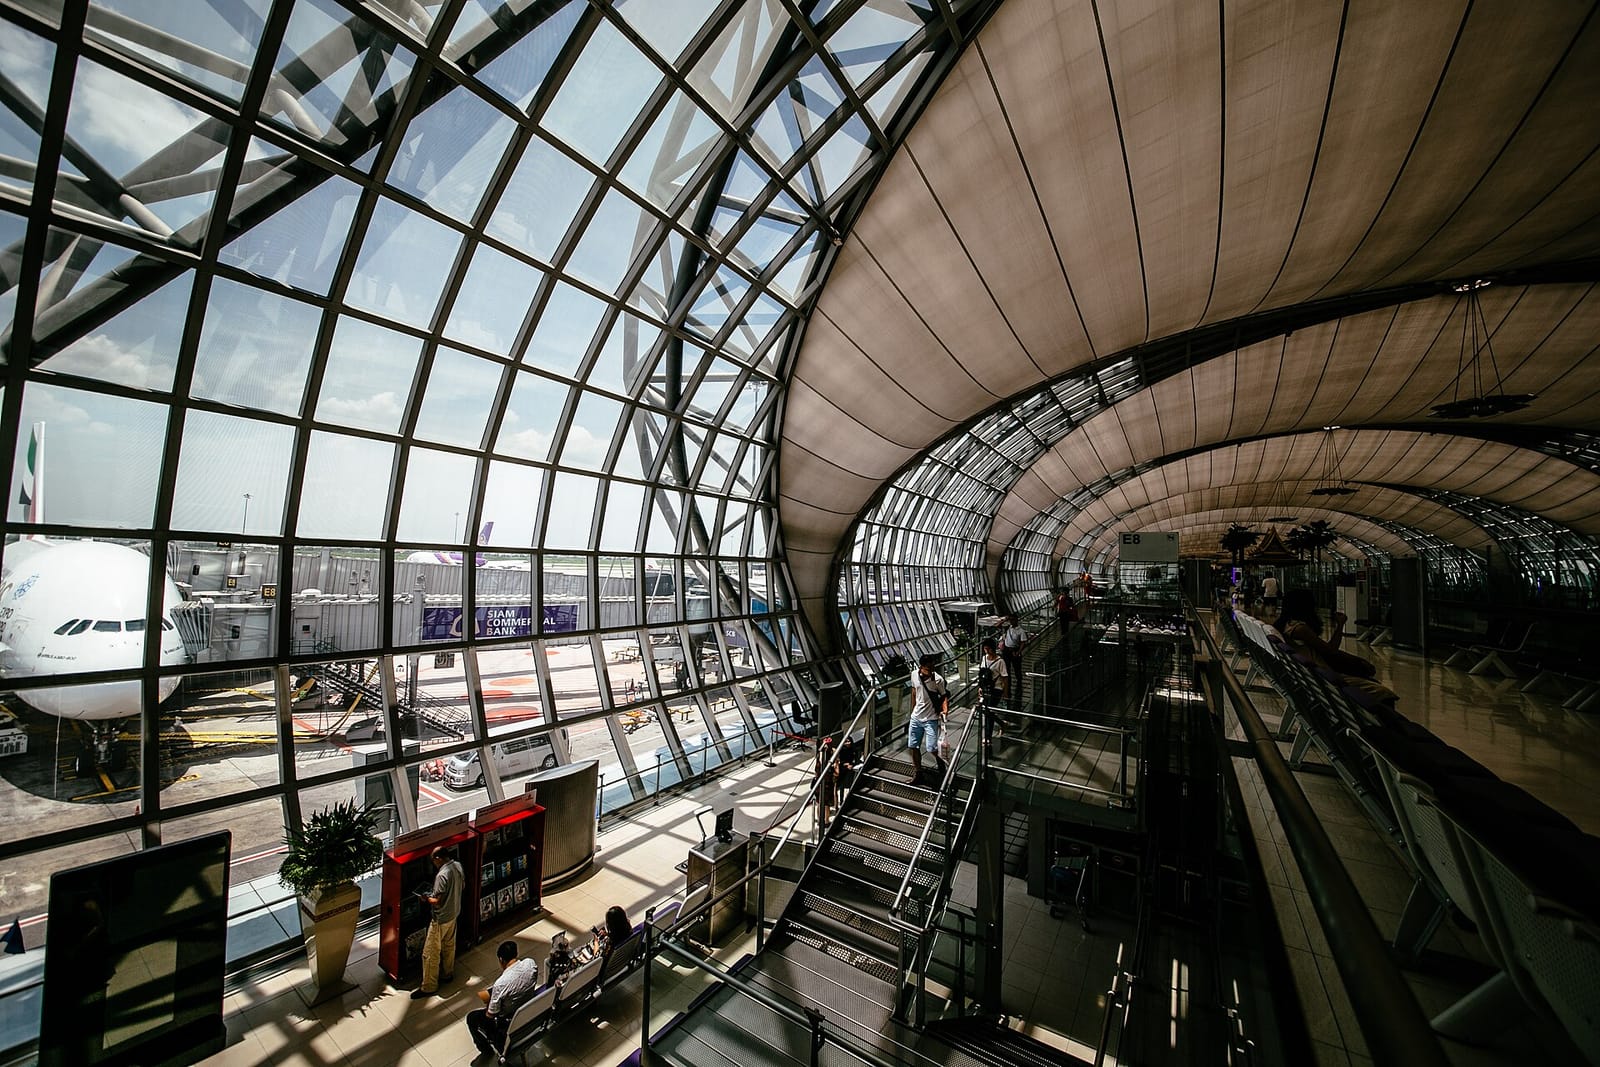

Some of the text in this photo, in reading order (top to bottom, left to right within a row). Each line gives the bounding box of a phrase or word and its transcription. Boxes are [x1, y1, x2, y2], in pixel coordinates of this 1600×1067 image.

[1123, 534, 1140, 544] E8
[264, 587, 276, 597] E8
[487, 610, 515, 618] SIAM
[487, 617, 556, 627] COMMERAL
[486, 627, 516, 635] BANK
